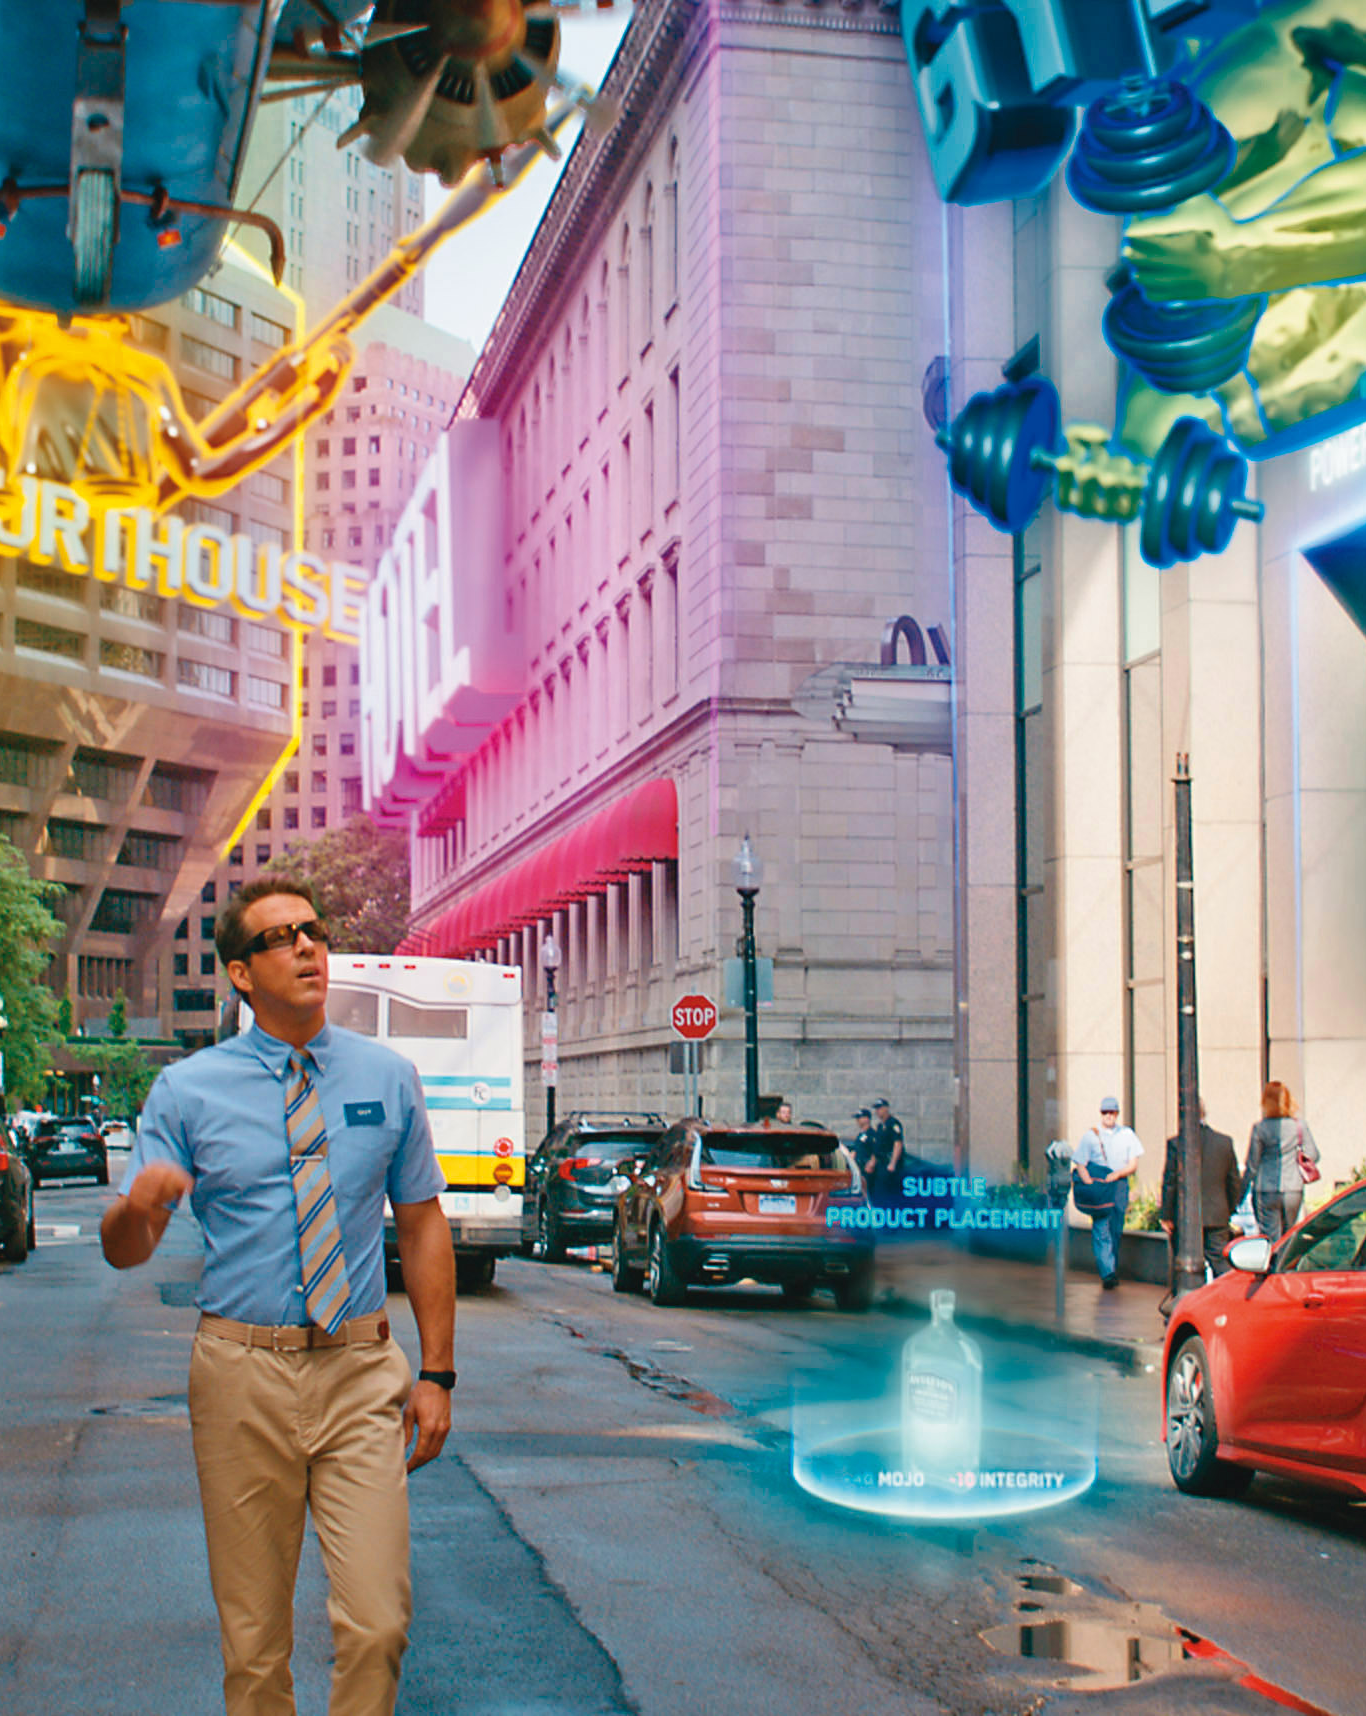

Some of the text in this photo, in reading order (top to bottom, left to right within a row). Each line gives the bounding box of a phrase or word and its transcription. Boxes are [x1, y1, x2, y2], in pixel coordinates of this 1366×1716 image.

[674, 1007, 714, 1027] STOP
[902, 1176, 986, 1197] SUBTLE
[826, 1206, 1064, 1229] PRODUCT PLACEMENT
[877, 1471, 925, 1487] MOJO
[979, 1472, 1066, 1488] INTEGRITY
